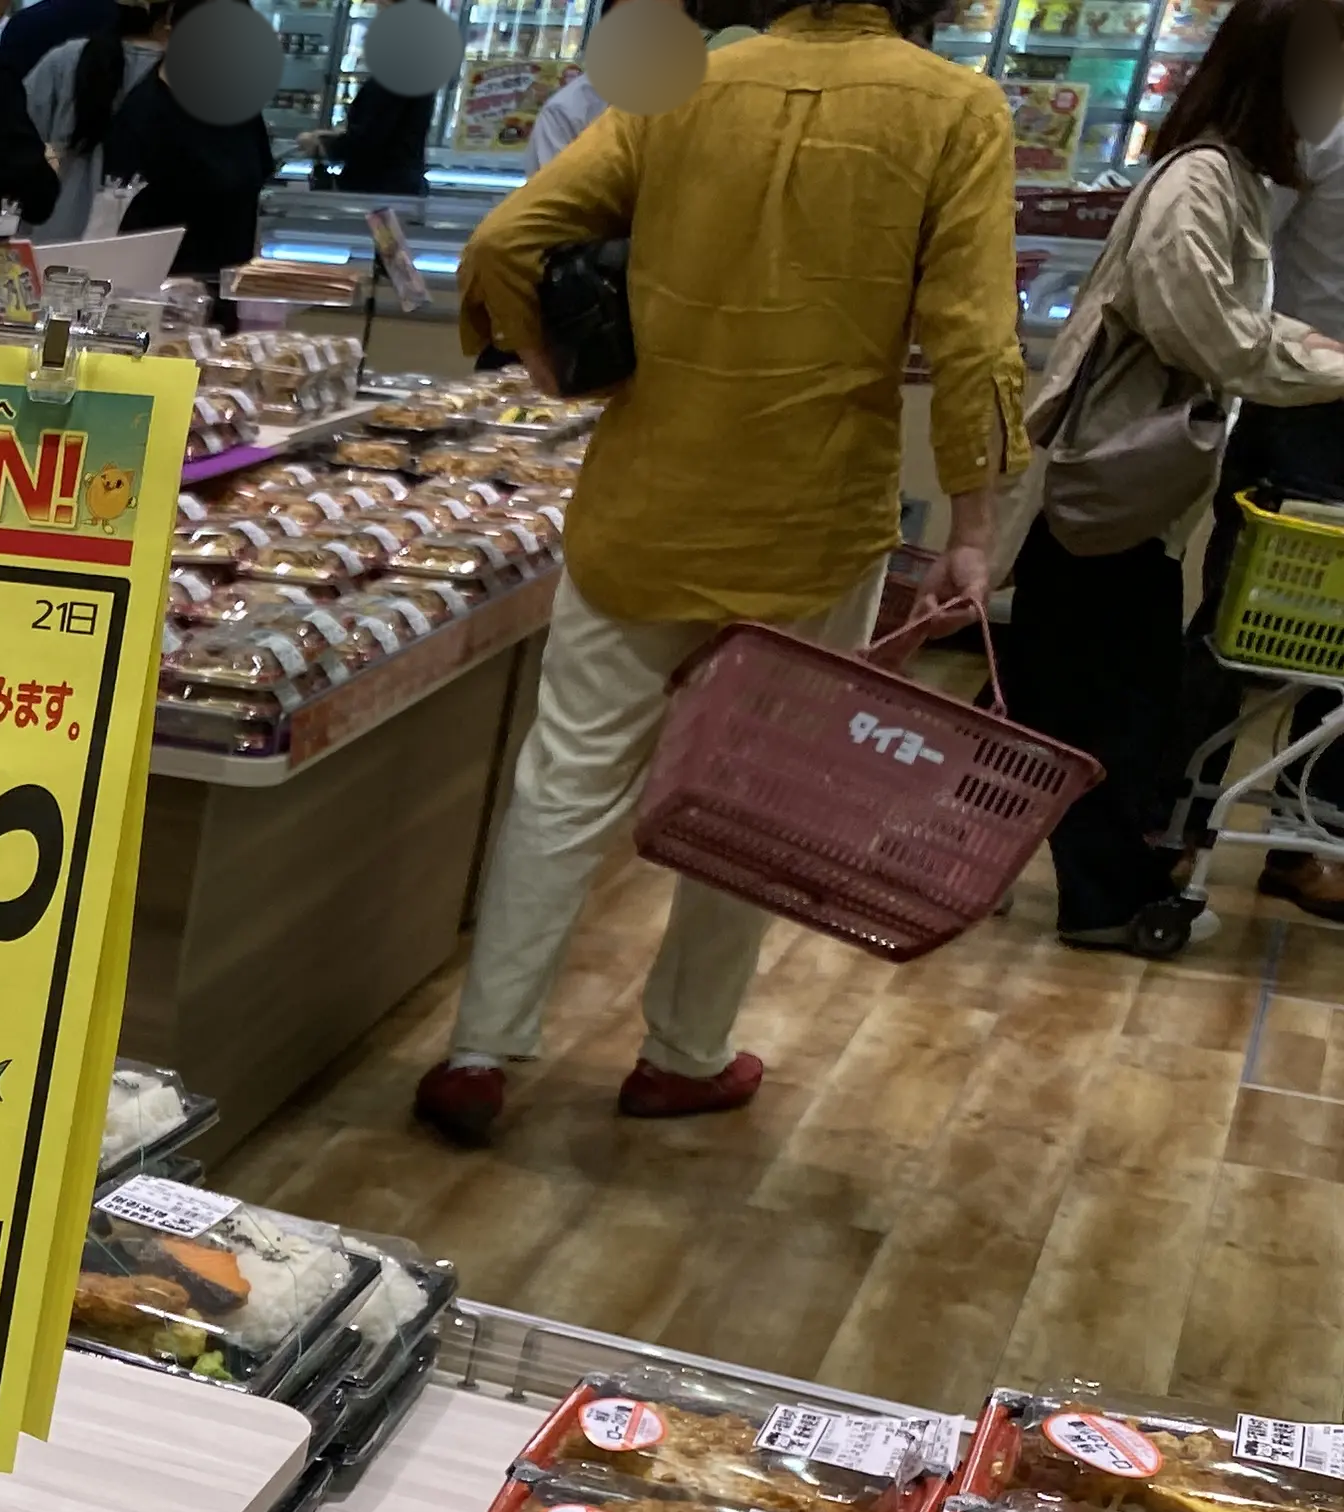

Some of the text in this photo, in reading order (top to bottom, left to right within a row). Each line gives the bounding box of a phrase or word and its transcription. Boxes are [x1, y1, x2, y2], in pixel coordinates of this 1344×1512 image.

[31, 599, 99, 637] 21日
[848, 710, 945, 766] タイヨー
